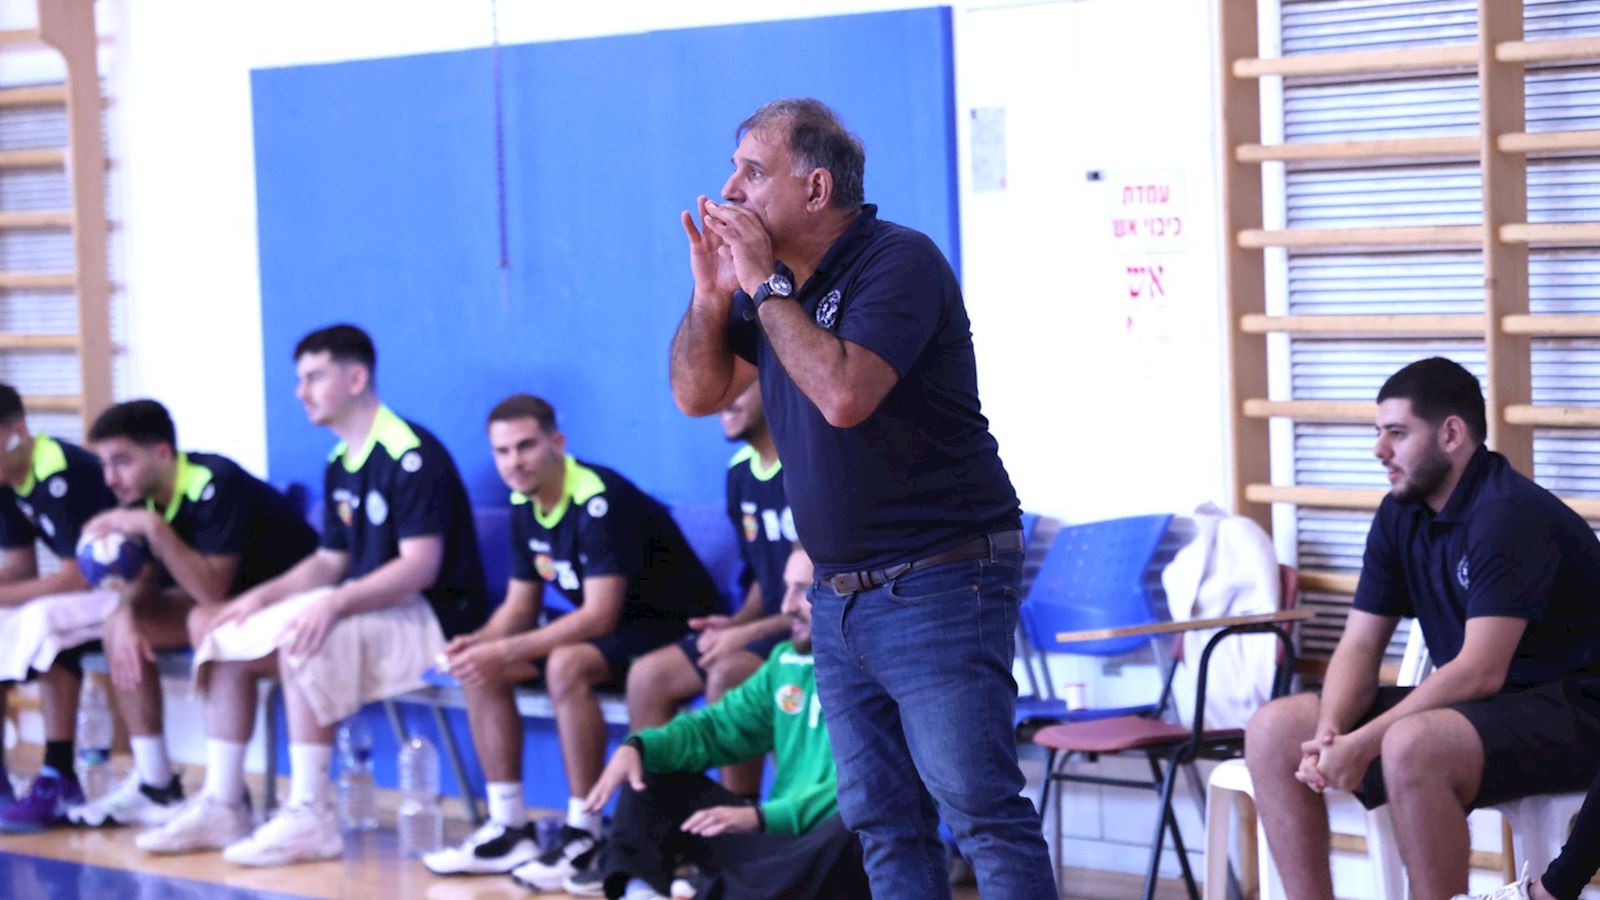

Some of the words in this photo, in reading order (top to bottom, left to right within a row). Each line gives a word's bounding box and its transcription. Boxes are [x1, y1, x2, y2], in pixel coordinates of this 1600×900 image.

[1122, 185, 1170, 205] עמדת
[1111, 218, 1137, 238] אש
[1143, 216, 1182, 236] כיבוי
[1126, 264, 1165, 299] אש
